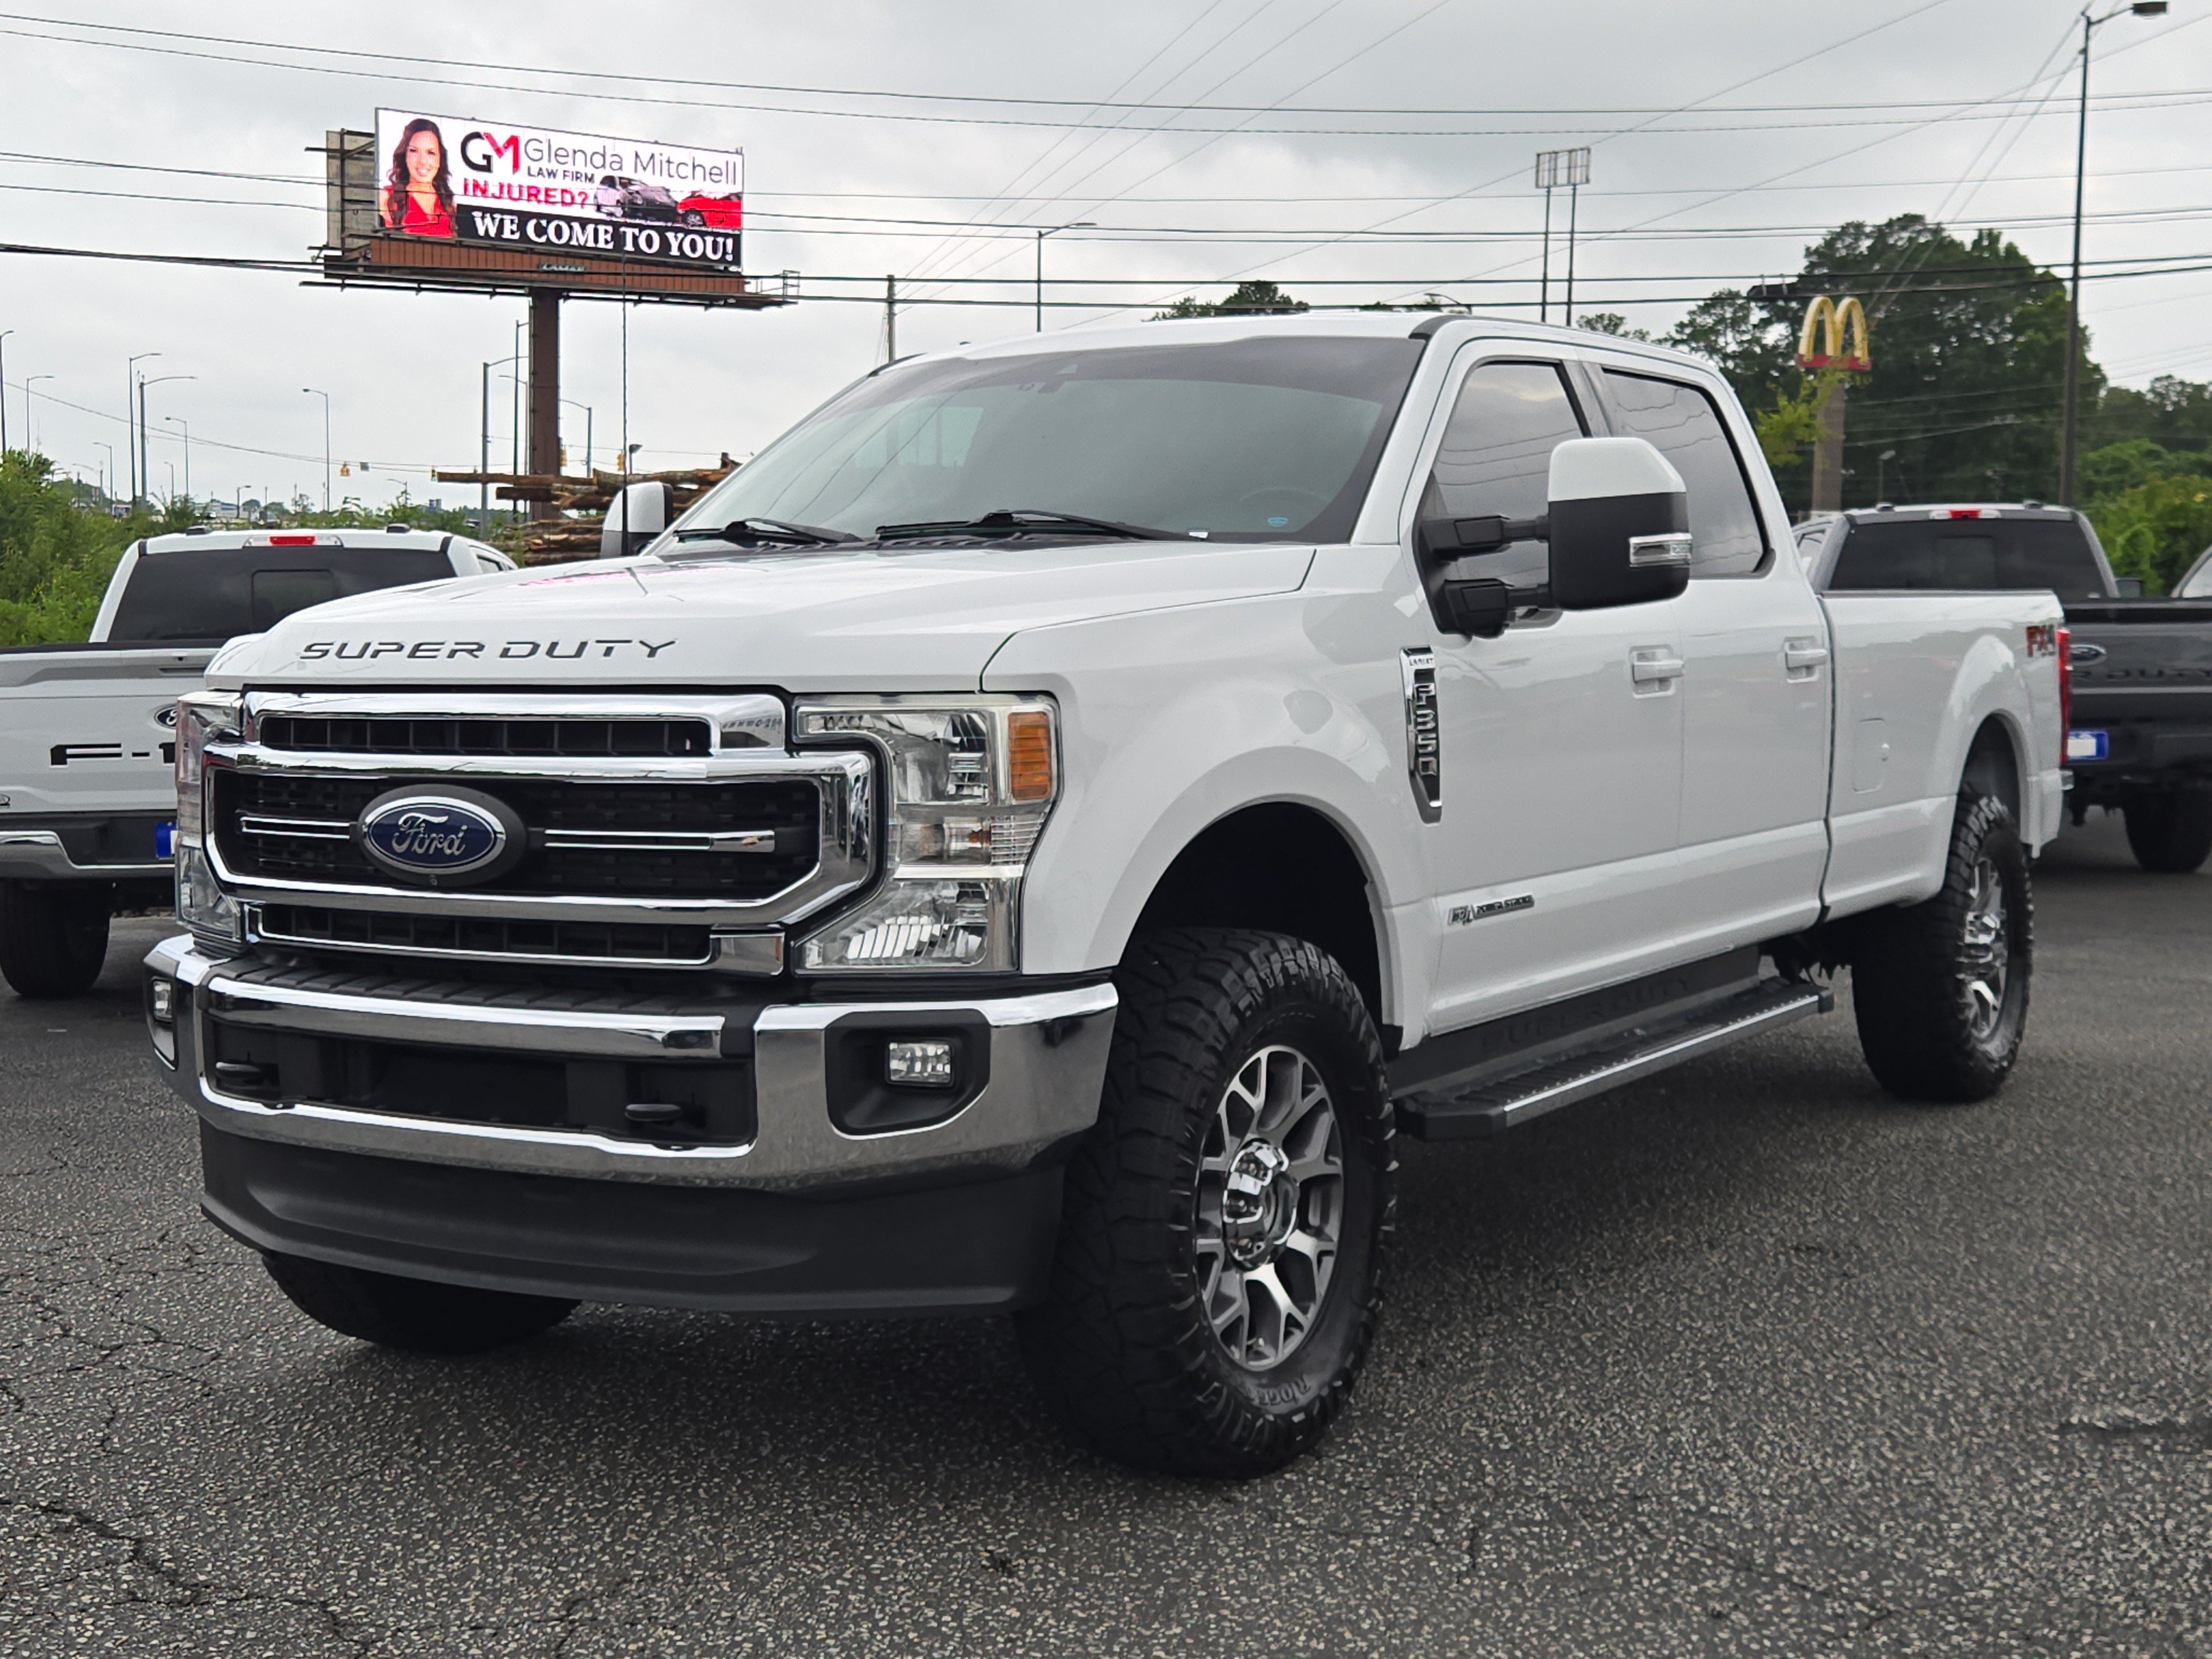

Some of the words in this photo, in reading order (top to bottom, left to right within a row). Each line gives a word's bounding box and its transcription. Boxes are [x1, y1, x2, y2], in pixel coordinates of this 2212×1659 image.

[461, 131, 520, 175] GM
[524, 138, 623, 171] Glenda
[634, 150, 736, 185] Mitchell
[464, 177, 589, 209] INJURED?
[528, 166, 557, 179] LAW
[563, 170, 594, 184] FIRM
[471, 211, 520, 240] WE
[526, 218, 614, 249] COME
[620, 227, 660, 254] TO
[665, 232, 734, 261] YOU!
[300, 641, 485, 659] SUPER
[499, 639, 676, 659] DUTY
[50, 743, 176, 766] F-1
[391, 812, 466, 856] Ford
